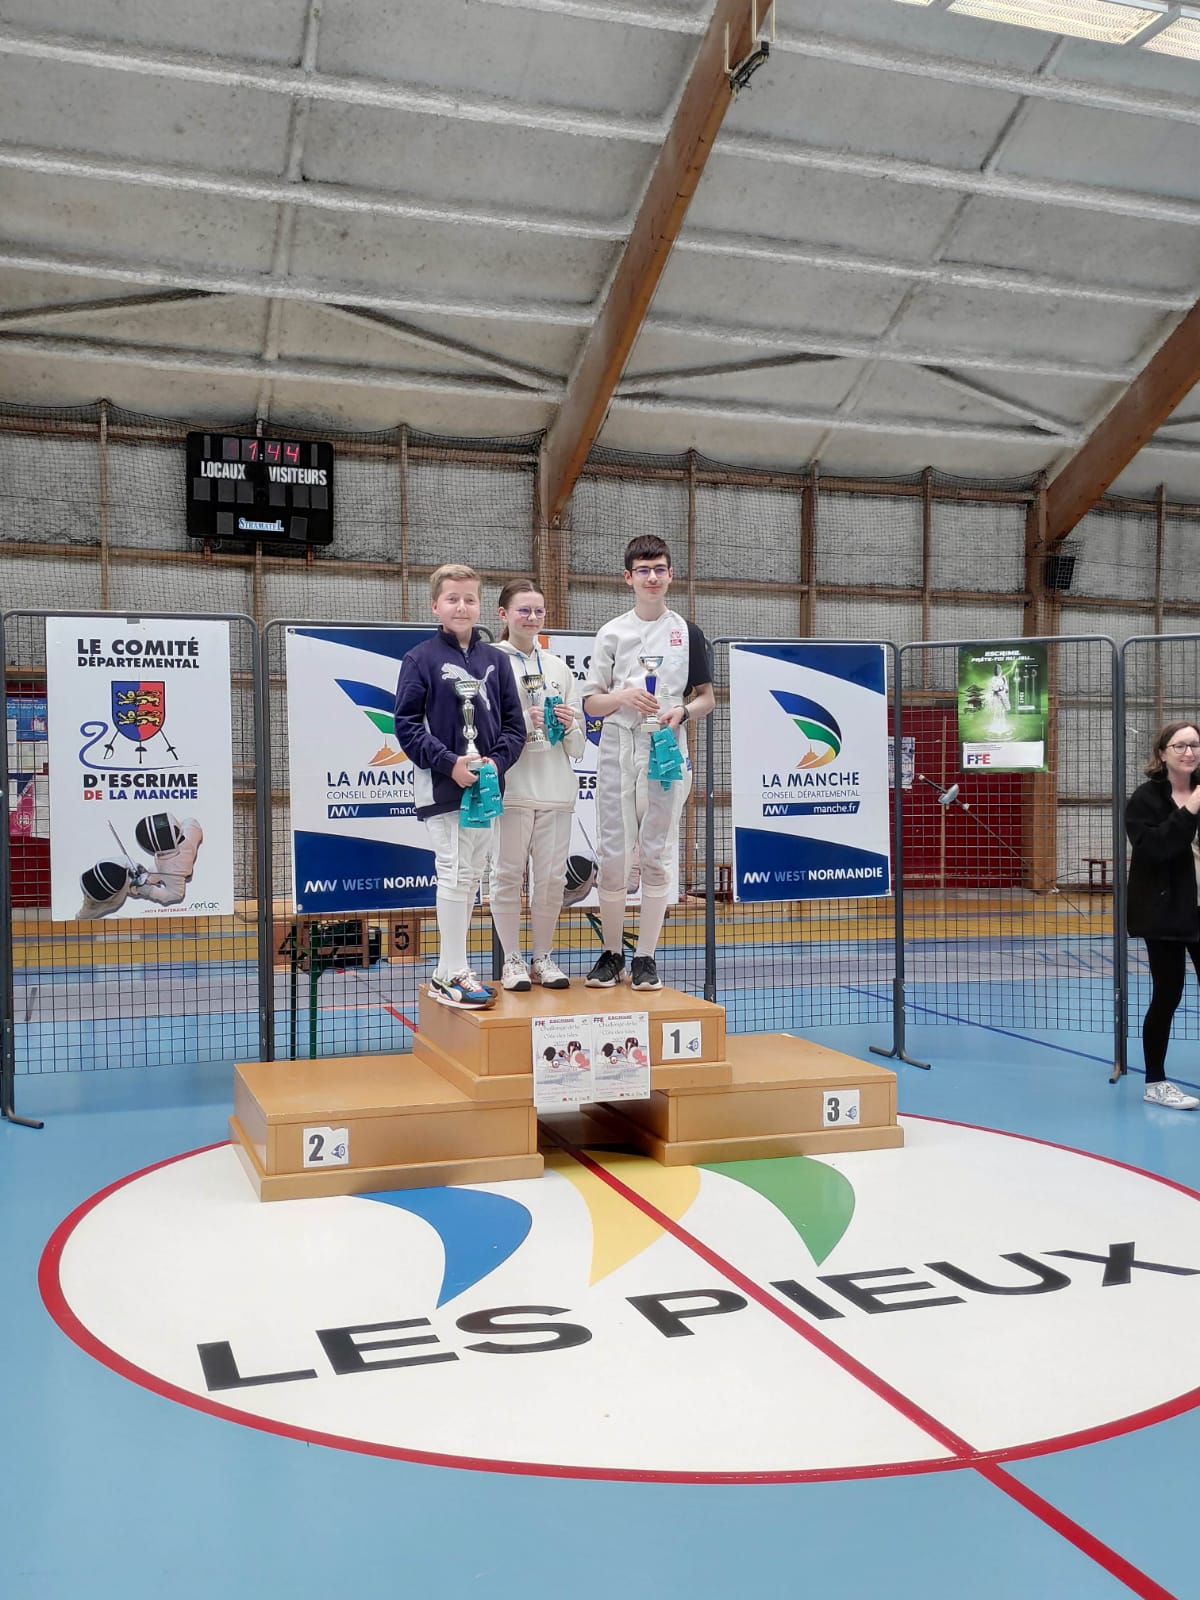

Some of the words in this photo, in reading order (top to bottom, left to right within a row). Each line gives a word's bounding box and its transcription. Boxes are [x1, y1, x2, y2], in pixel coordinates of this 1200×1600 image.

[201, 461, 246, 480] LOCAUX
[268, 466, 327, 486] VISITEURS
[77, 639, 101, 655] LE
[112, 636, 199, 656] COMITÉ
[78, 654, 199, 668] DÉPARTEMENTAL
[967, 754, 991, 765] FFE
[83, 773, 198, 788] D'ESCRIME
[327, 771, 351, 787] LA
[762, 773, 782, 788] LA
[787, 772, 860, 787] MANCHE
[84, 790, 103, 800] DE
[109, 790, 128, 800] LA
[134, 789, 198, 800] MANCHE
[327, 791, 367, 799] CONSEIL
[579, 791, 594, 800] LA
[762, 791, 795, 799] CONSEIL
[813, 803, 856, 814] manche.fr
[774, 870, 806, 882] WEST
[808, 867, 883, 880] NORMANDIE
[343, 877, 381, 891] WEST
[395, 925, 410, 950] 5
[670, 1029, 680, 1053] 1
[827, 1097, 840, 1122] 3
[309, 1134, 324, 1161] 2
[197, 1305, 592, 1391] LES
[624, 1242, 1200, 1338] PIEUX
